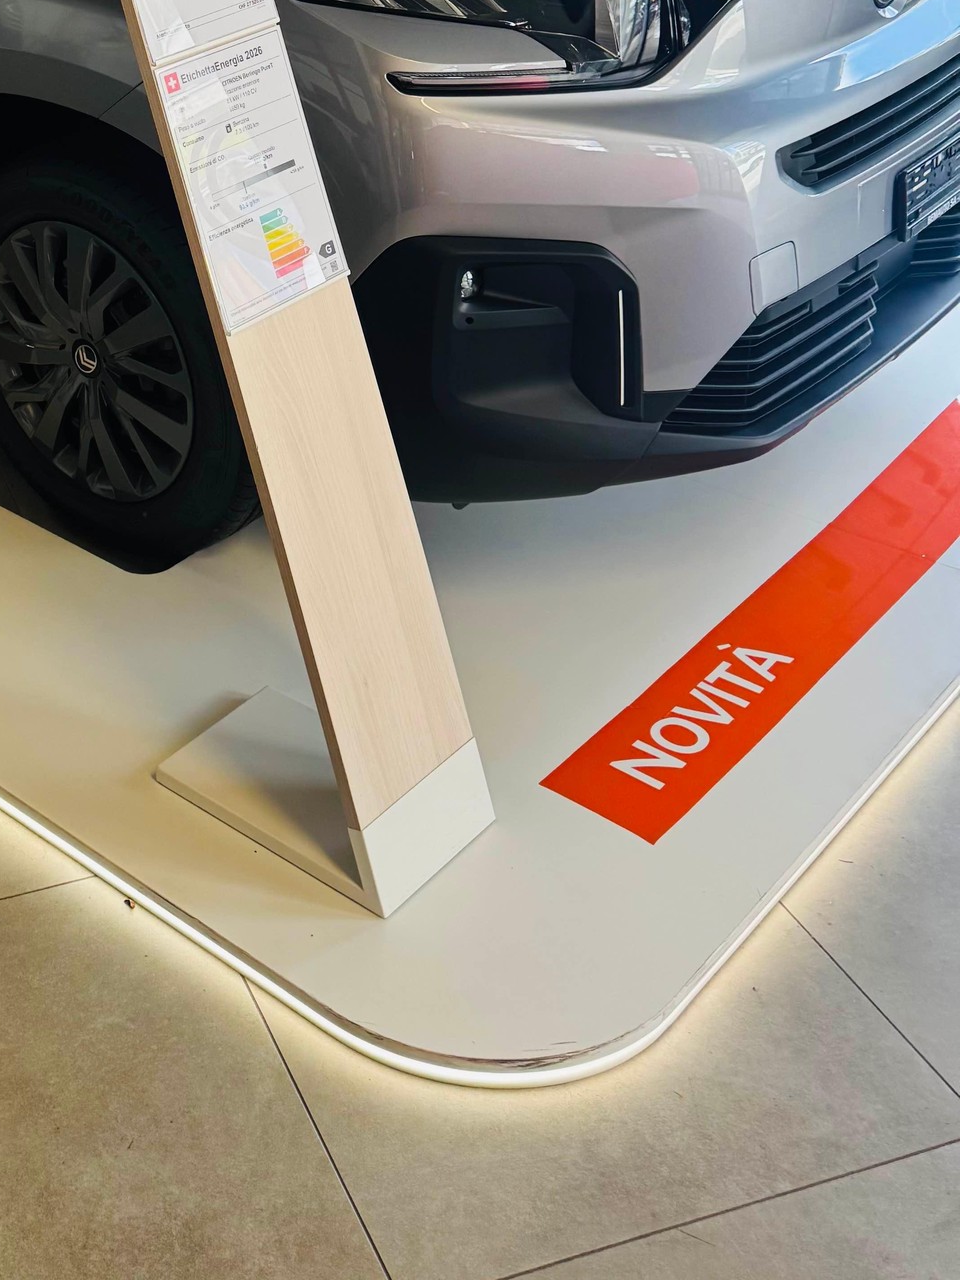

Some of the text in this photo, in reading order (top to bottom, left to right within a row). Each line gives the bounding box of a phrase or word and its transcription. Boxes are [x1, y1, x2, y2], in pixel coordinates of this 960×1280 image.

[180, 46, 262, 84] EtichettaEnergia 2026
[325, 244, 332, 254] G
[609, 643, 795, 790] NOVITÀ
